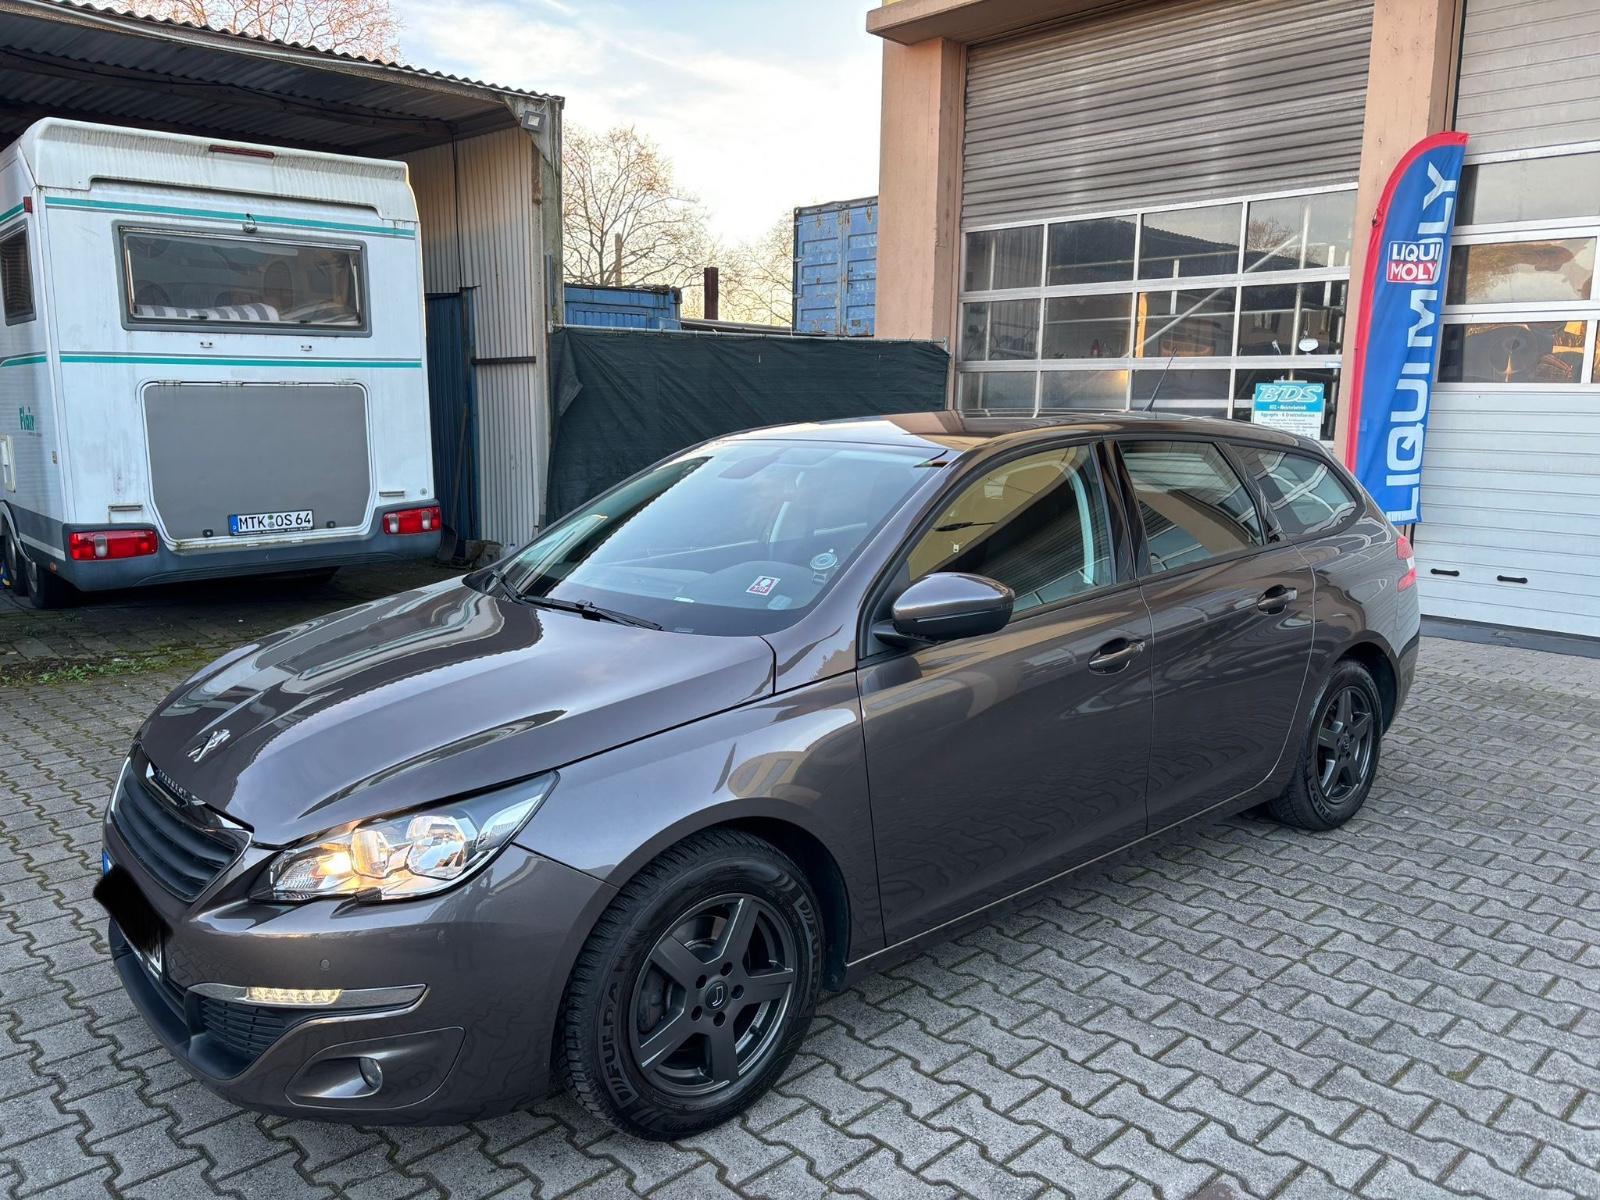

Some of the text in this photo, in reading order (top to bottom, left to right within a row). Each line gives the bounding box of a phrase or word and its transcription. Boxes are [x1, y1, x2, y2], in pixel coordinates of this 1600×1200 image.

[1392, 243, 1441, 262] LIQUI
[1389, 262, 1437, 281] MOLY
[1257, 385, 1322, 403] BDS
[1386, 362, 1430, 523] LIQUI
[239, 515, 266, 530] MTK
